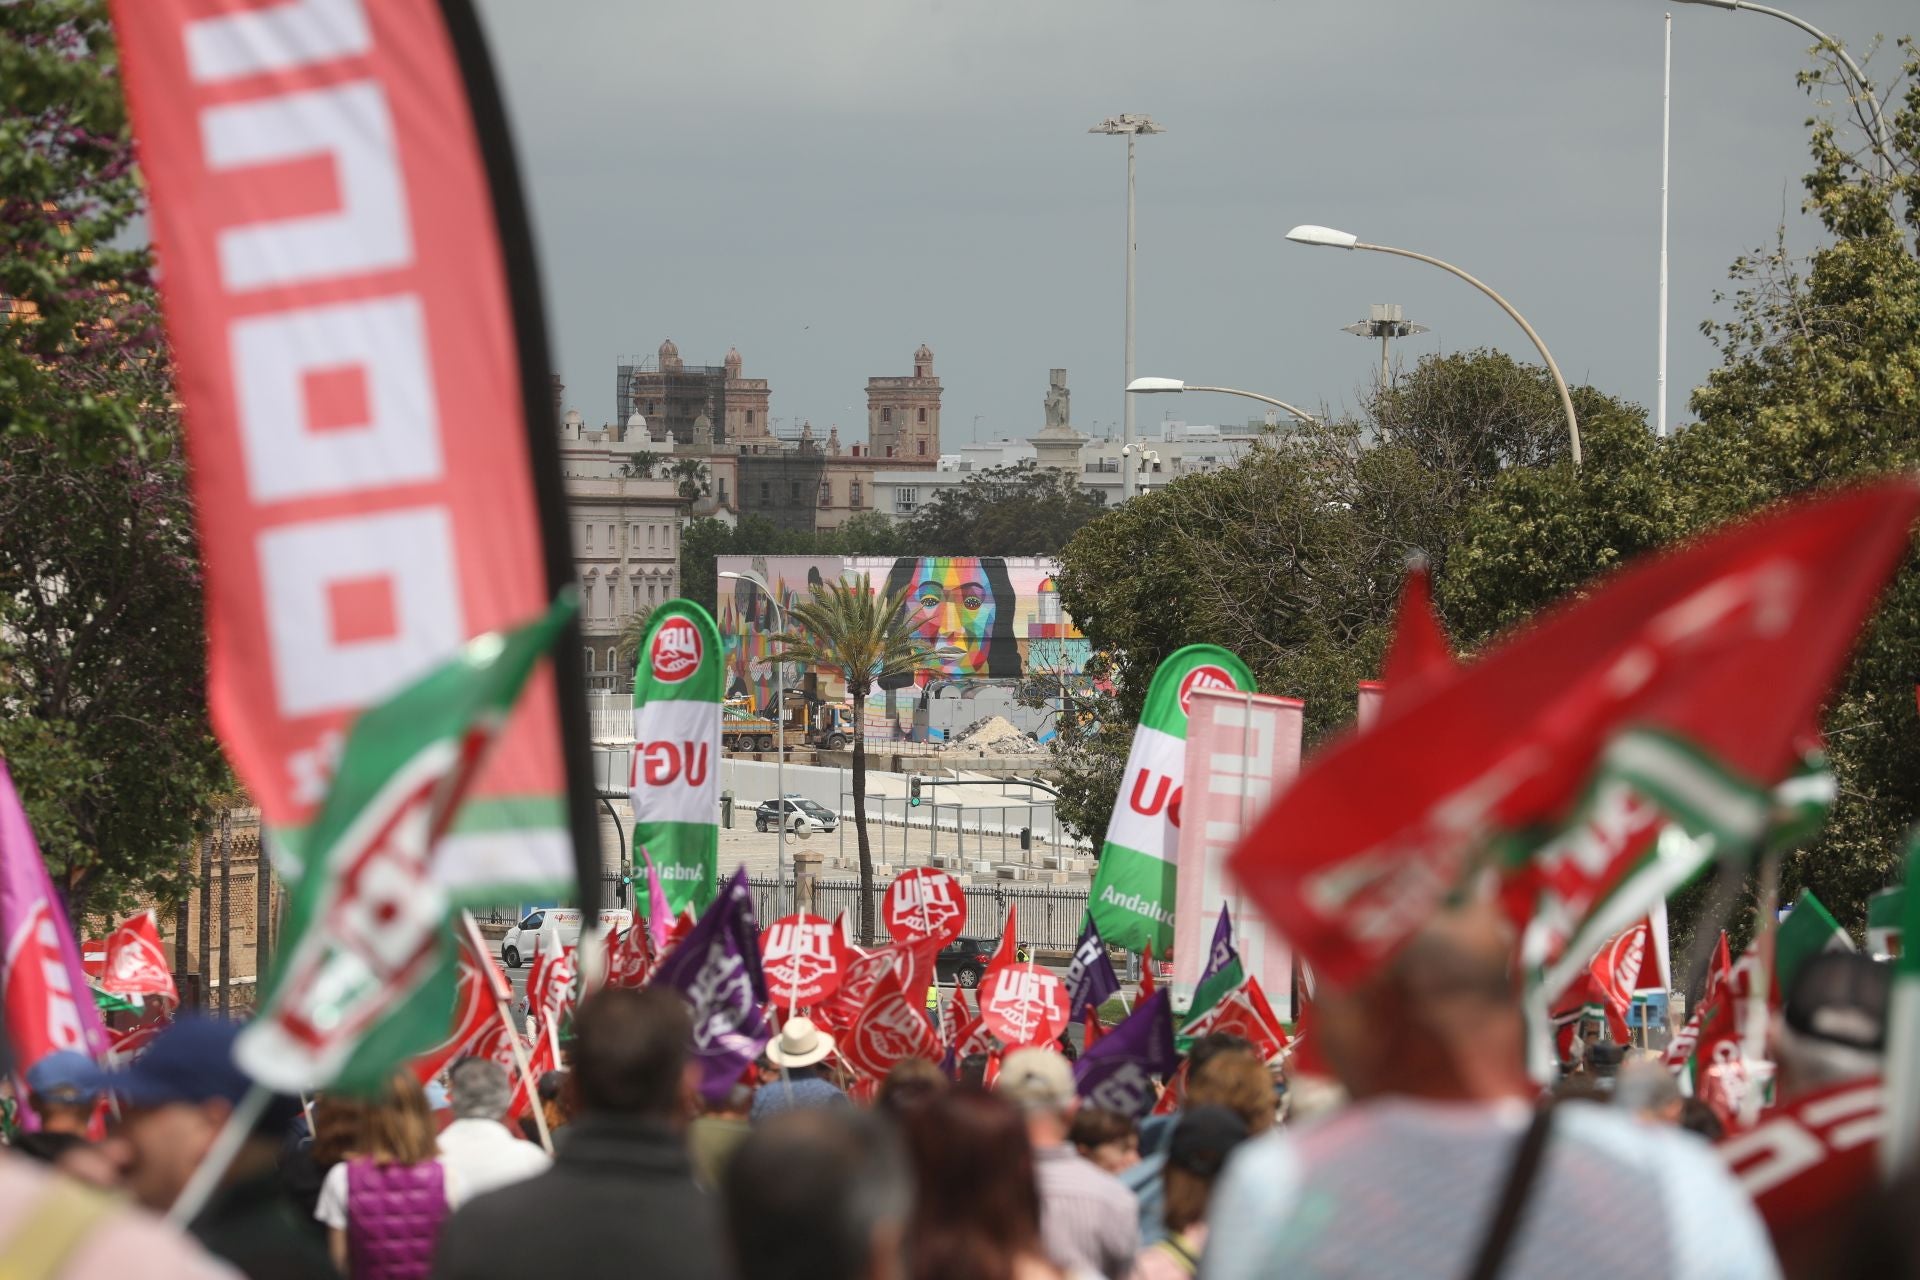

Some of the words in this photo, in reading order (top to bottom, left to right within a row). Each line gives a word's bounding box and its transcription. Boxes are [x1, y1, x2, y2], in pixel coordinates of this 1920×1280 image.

[893, 874, 950, 913] UGT
[1100, 884, 1175, 927] Andaluc
[764, 923, 834, 960] UGT
[996, 968, 1058, 1008] UGT
